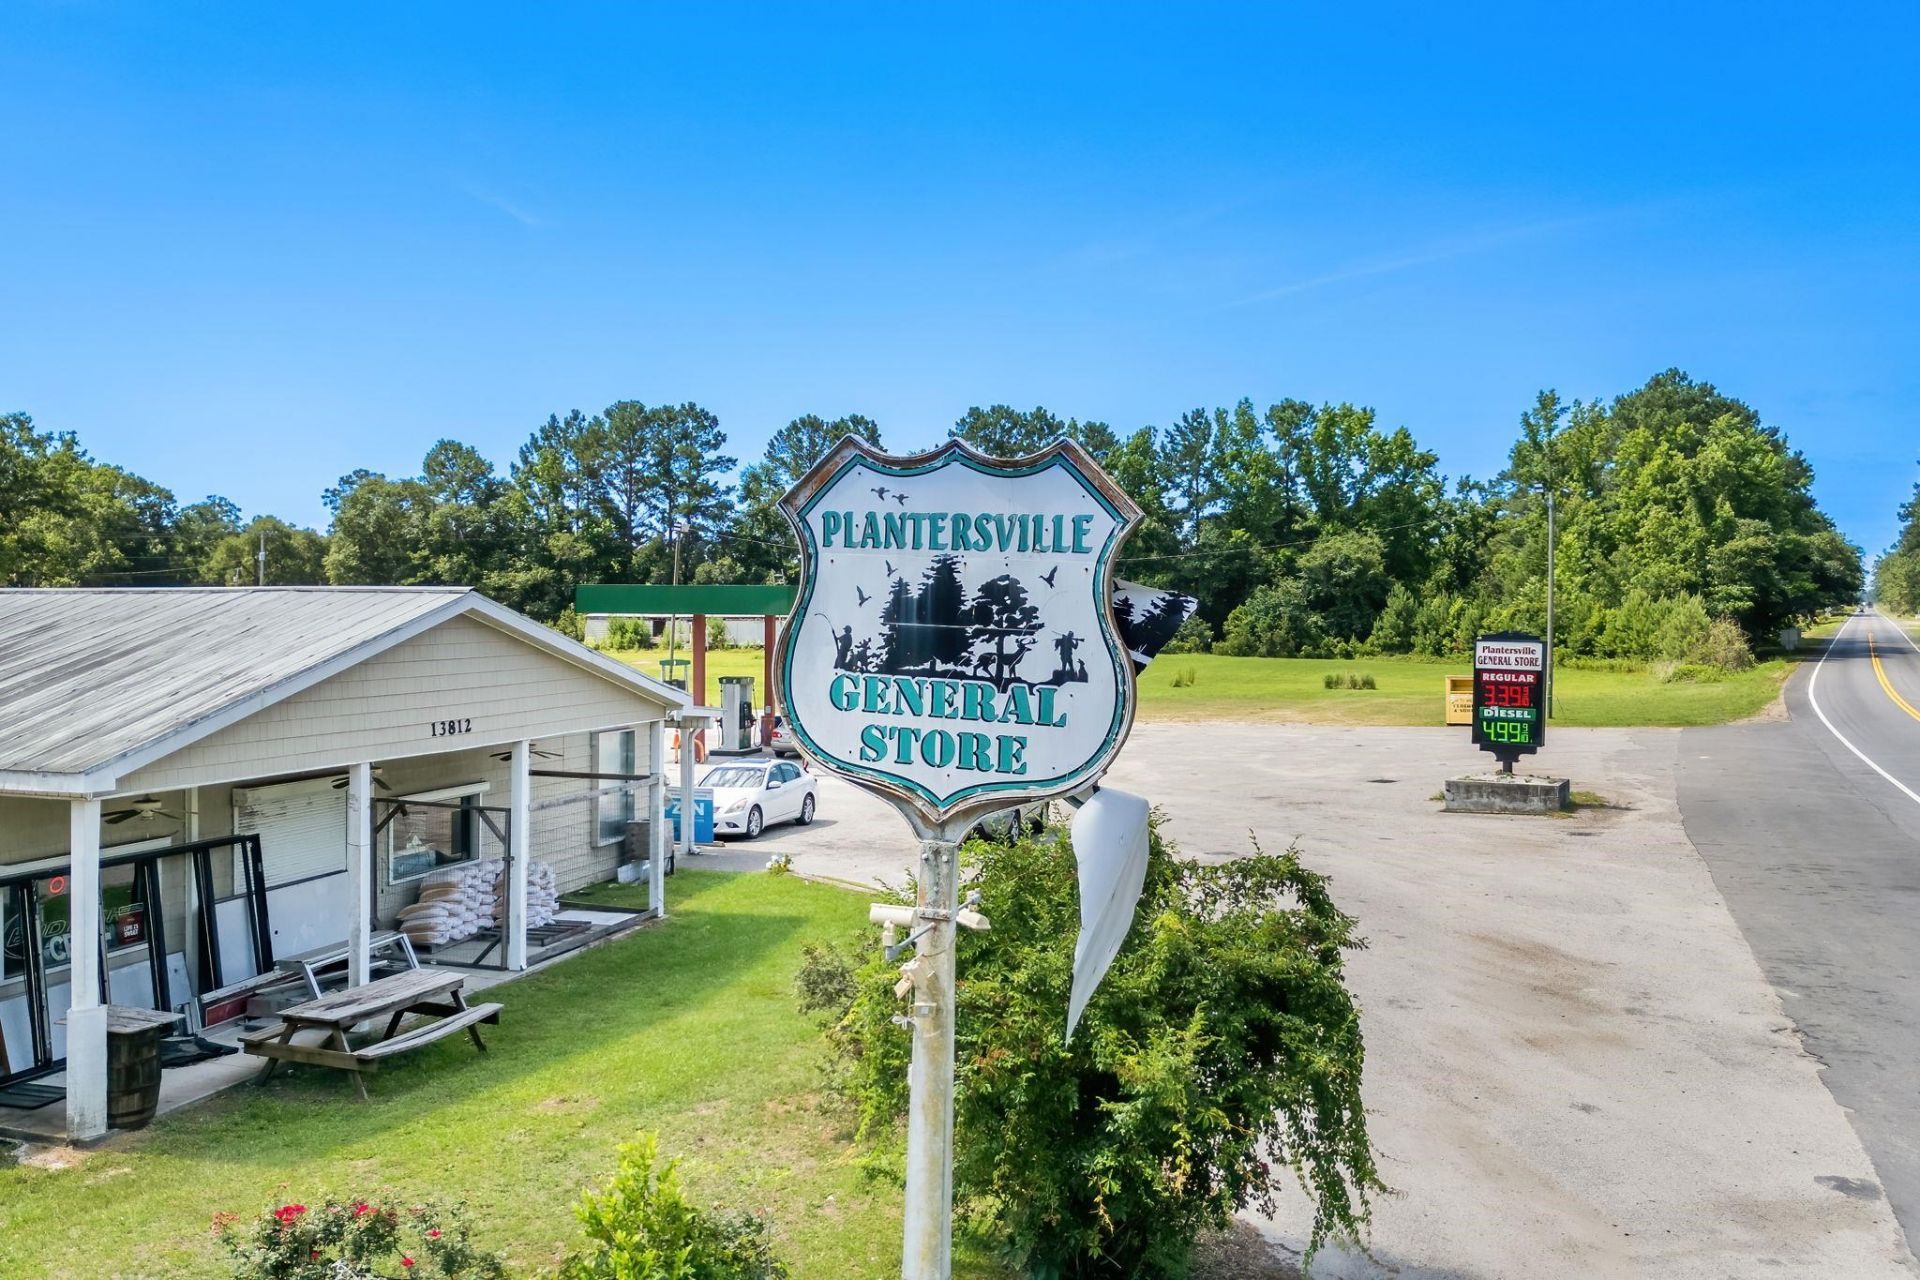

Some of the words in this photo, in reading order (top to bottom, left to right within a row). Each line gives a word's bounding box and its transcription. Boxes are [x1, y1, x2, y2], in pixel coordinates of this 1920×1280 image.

[821, 510, 1095, 554] PLANTERSVILLE
[1482, 645, 1537, 655] Plantersville
[1477, 655, 1512, 666] GENERAL
[1514, 657, 1541, 667] STORE
[1482, 672, 1535, 682] REGULAR
[828, 672, 1068, 729] GENERAL
[1483, 706, 1531, 718] DIESEL
[431, 718, 472, 737] 13812
[859, 724, 1029, 776] STORE
[671, 801, 705, 816] ZN
